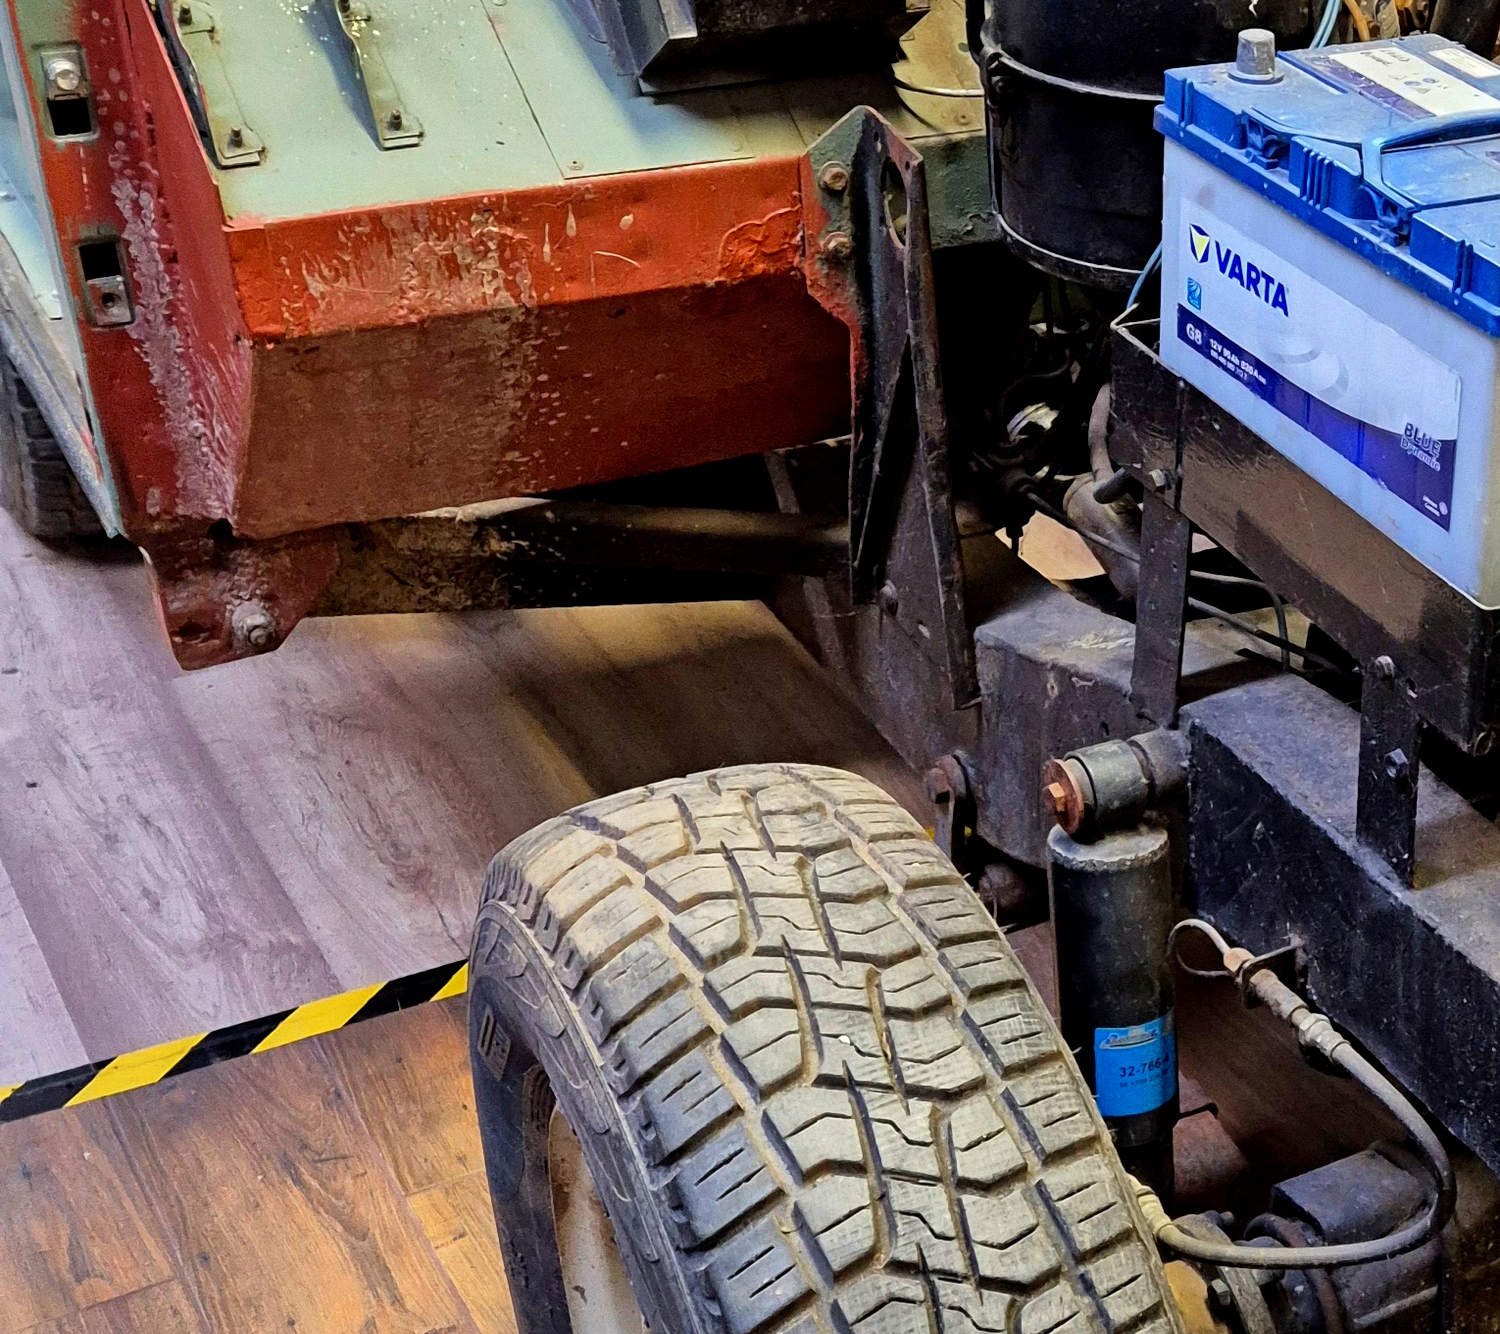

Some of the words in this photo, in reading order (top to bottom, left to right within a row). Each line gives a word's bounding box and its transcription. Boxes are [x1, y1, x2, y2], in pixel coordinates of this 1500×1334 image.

[1214, 239, 1289, 318] VARTA
[1186, 323, 1202, 345] G8
[1404, 422, 1441, 460] BLUE
